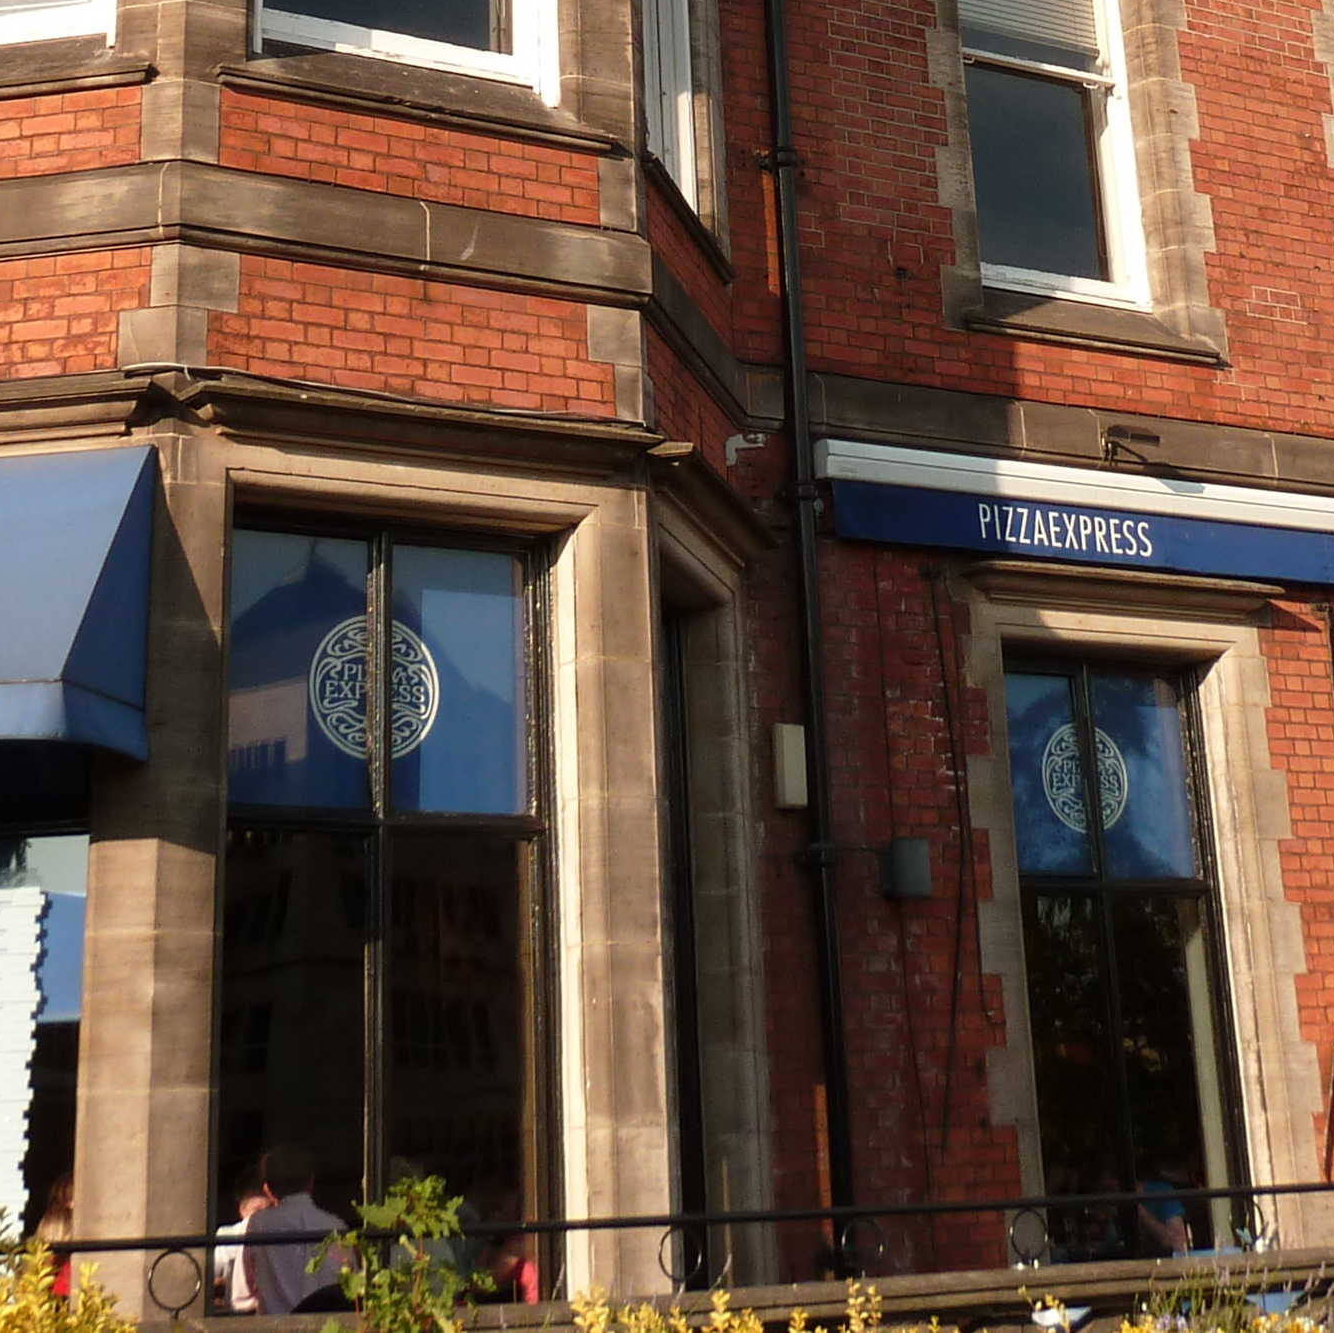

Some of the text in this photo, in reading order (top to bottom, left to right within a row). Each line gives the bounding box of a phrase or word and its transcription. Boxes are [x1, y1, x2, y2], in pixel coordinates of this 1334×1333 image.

[978, 503, 1153, 557] PIZZAEXPRESS
[344, 663, 407, 684] PIA
[325, 679, 425, 703] EXPSS
[1052, 772, 1119, 788] EXPSS
